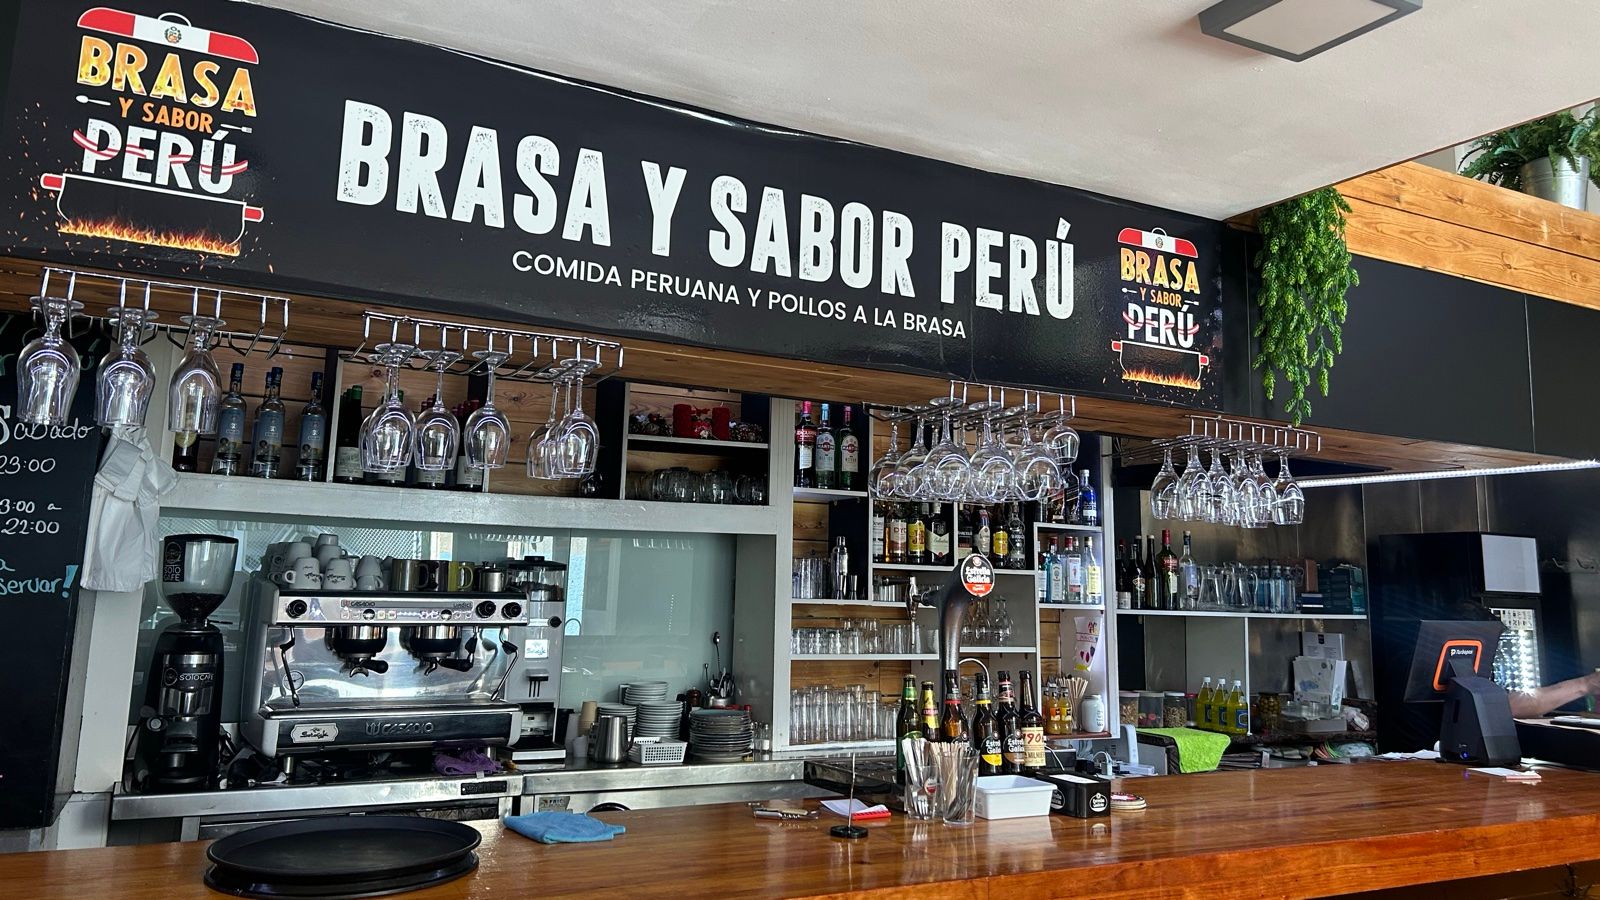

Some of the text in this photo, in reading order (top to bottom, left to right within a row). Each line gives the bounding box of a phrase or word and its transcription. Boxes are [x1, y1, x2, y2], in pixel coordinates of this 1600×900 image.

[77, 35, 257, 117] BRASA
[118, 97, 214, 134] Y SABOR
[82, 118, 237, 194] PERÚ
[337, 99, 1075, 320] BRASA Y SABOR PERÚ
[1120, 247, 1201, 295] BRASA
[511, 250, 967, 339] COMIDA PERUANA Y POLLOS A LA BRASA
[1139, 286, 1182, 308] Y SABOR
[1128, 303, 1194, 348] PERÚ
[1, 517, 60, 535] 22:00
[47, 503, 62, 511] a
[164, 566, 181, 574] SOTO
